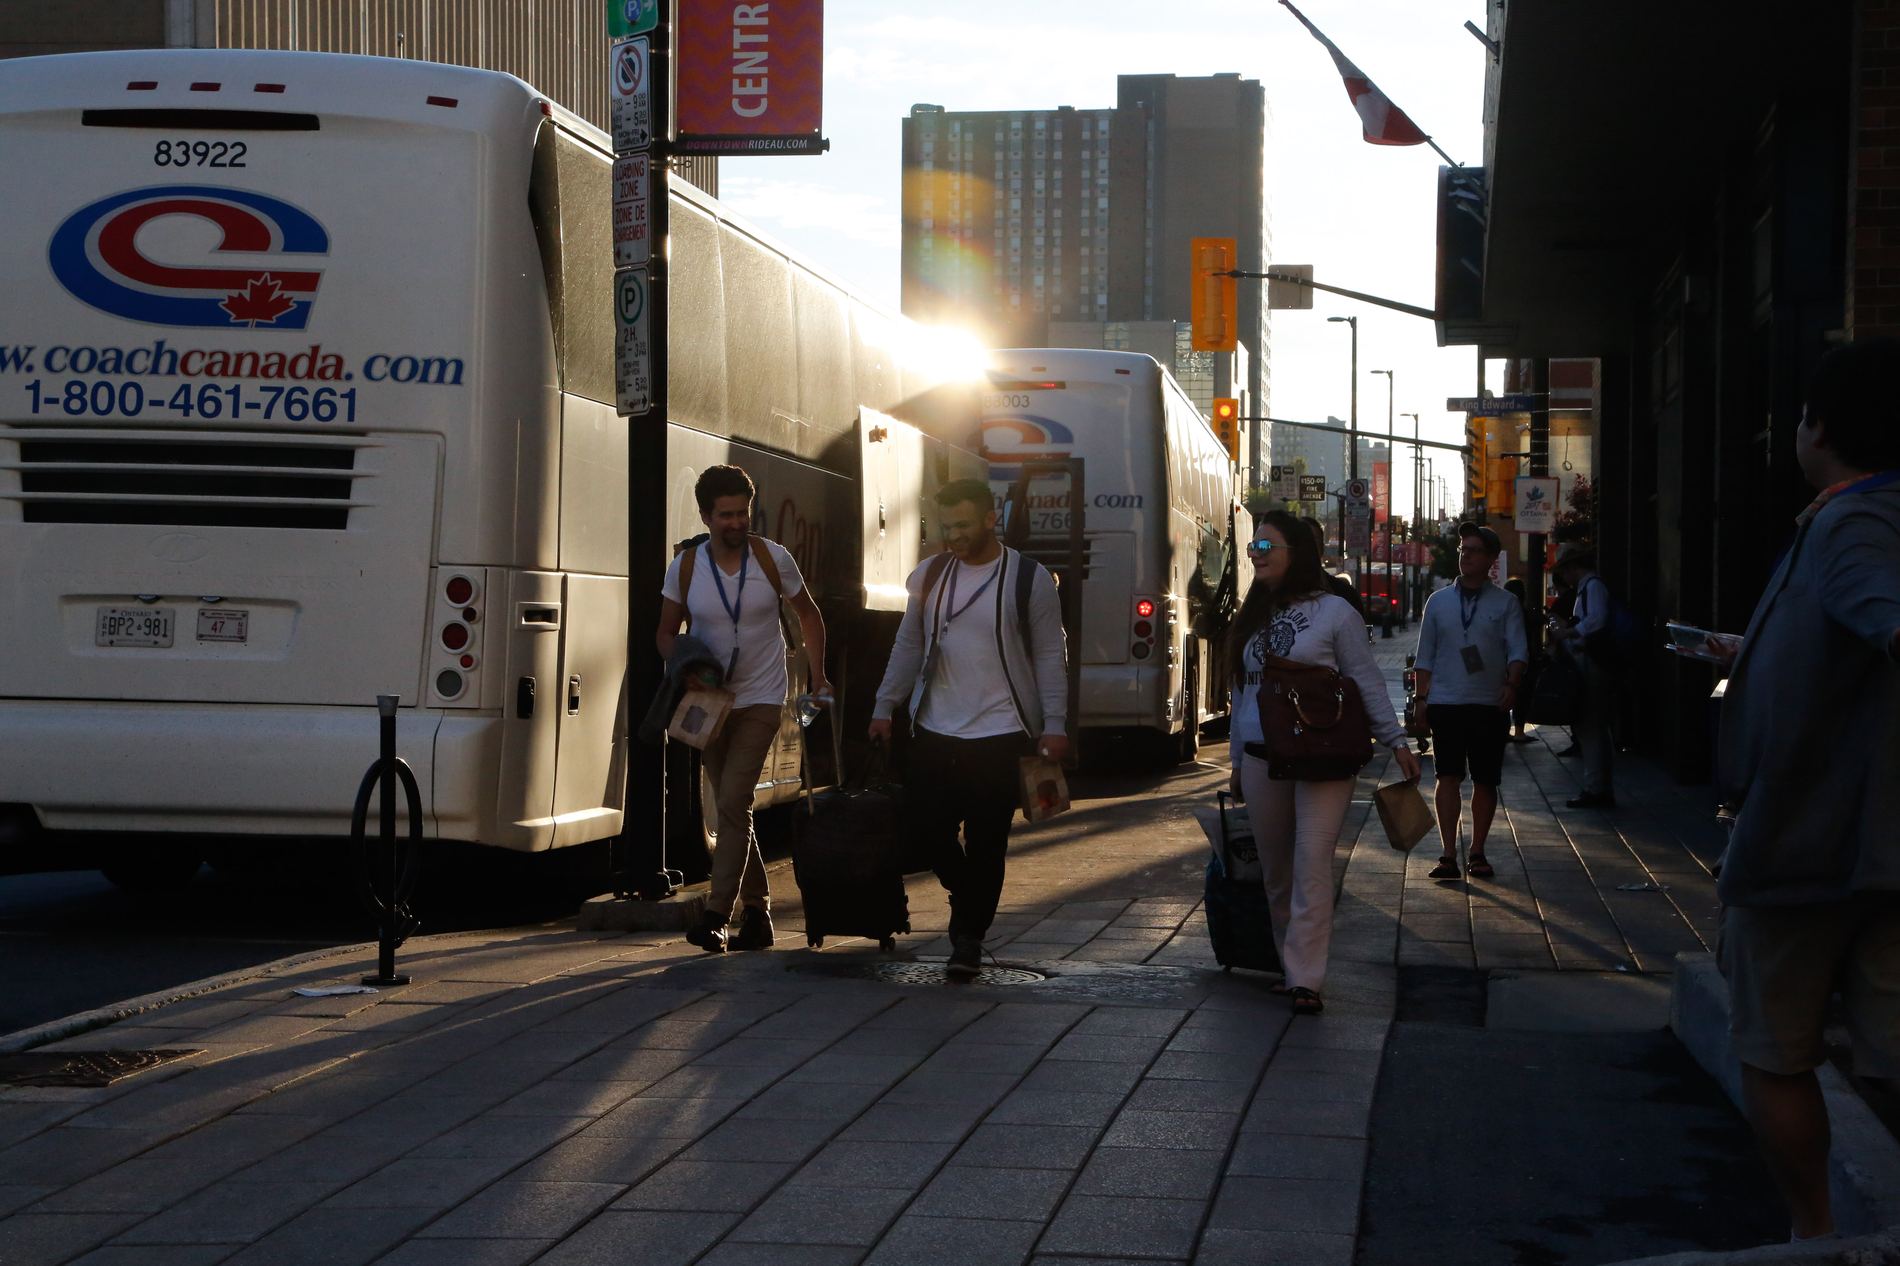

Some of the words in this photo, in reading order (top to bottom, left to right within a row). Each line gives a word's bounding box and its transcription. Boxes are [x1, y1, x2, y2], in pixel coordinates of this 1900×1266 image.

[154, 141, 247, 168] 83922
[615, 160, 645, 181] LOADING
[620, 180, 639, 198] ZONE
[615, 206, 633, 224] ZONE
[635, 204, 645, 221] DE
[25, 379, 358, 423] 1-800-461-7661
[1461, 400, 1479, 412] King
[1482, 399, 1515, 410] Edward
[1519, 510, 1548, 518] OTTAWA
[108, 617, 135, 636] BP2
[143, 617, 168, 638] 981
[211, 620, 226, 634] 47
